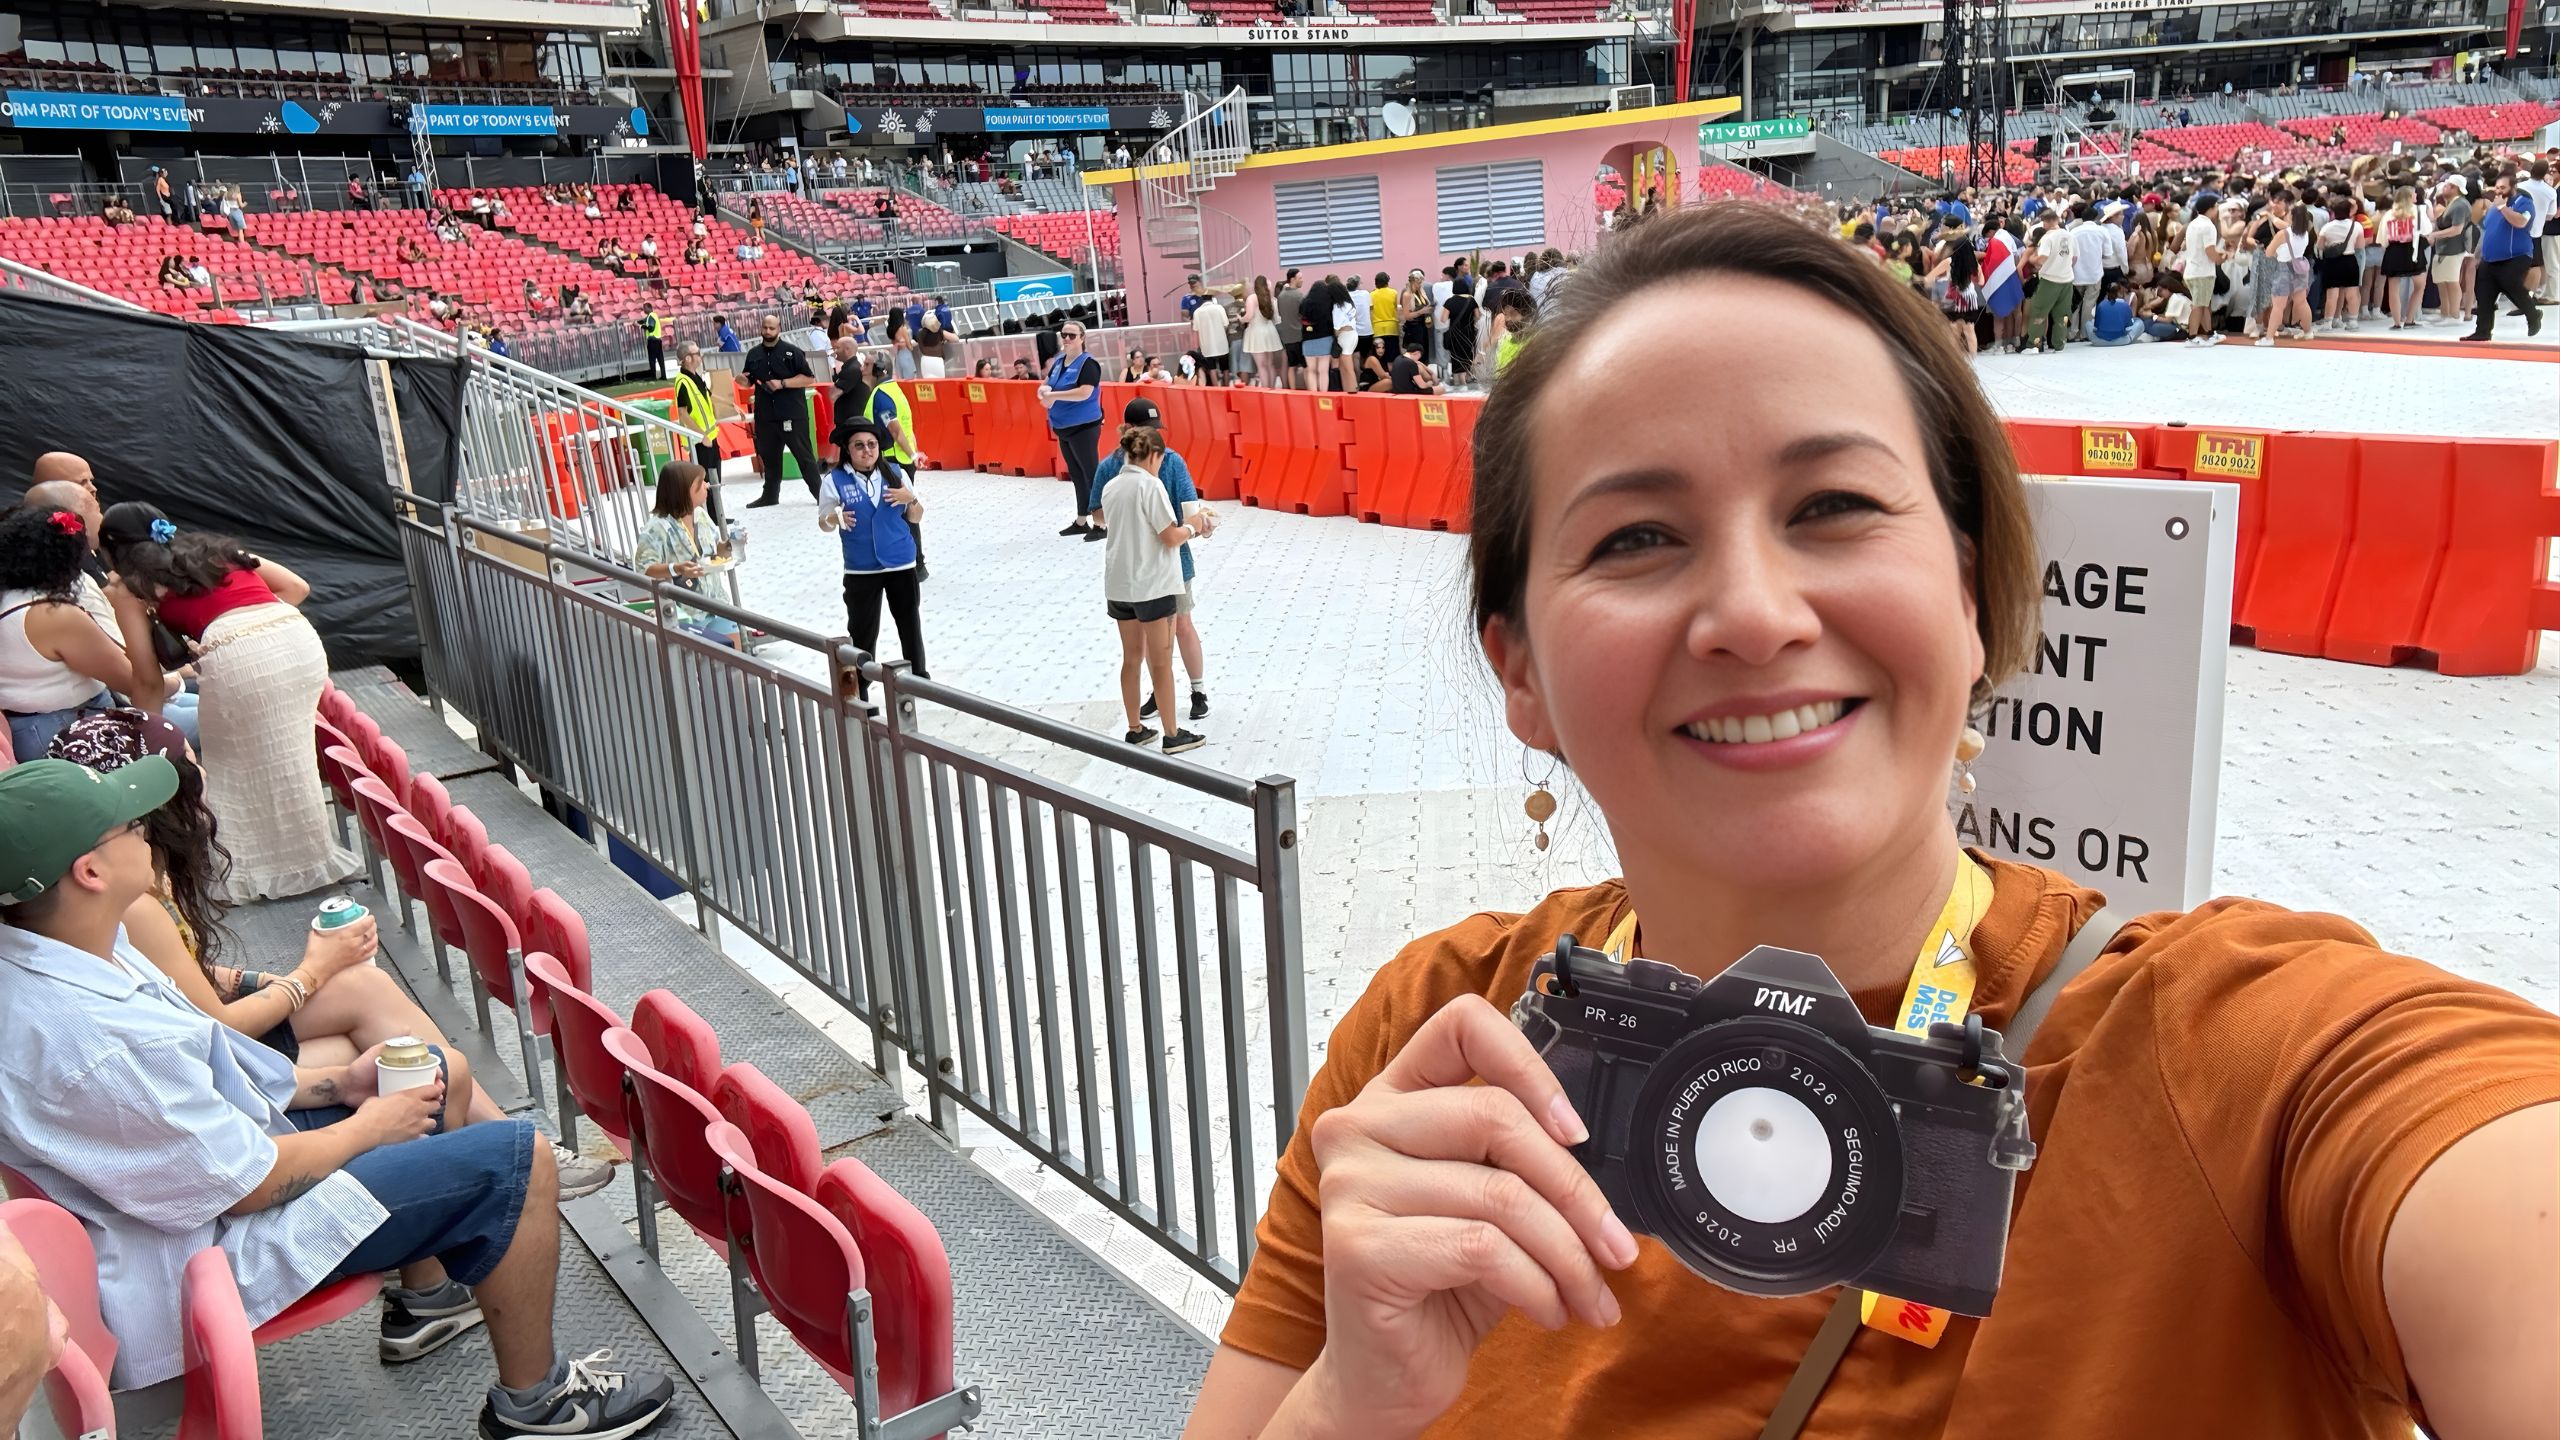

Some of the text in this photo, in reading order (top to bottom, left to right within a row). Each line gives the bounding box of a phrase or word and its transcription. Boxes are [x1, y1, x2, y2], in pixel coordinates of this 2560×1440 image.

[1248, 29, 1349, 40] SUTTOR STAND
[42, 103, 77, 118] PART
[81, 104, 100, 119] OF
[102, 105, 161, 121] TODAY'S
[164, 107, 205, 123] EVENT
[430, 114, 460, 127] PART
[463, 114, 479, 127] OF
[481, 114, 532, 127] TODAY'S
[534, 114, 570, 128] EVENT
[1738, 125, 1761, 138] EXIT
[2091, 432, 2127, 450] TFH
[2206, 435, 2250, 457] TFH
[2088, 449, 2133, 462] 9820 9022
[2201, 454, 2256, 470] 9820 9022
[2043, 559, 2148, 615] AGE
[2022, 630, 2108, 682] NT
[1987, 696, 2103, 756] TION
[1954, 802, 2149, 884] ANS OR
[1753, 987, 1817, 1016] DTMF
[1907, 984, 1937, 1029] MáS
[1584, 1005, 1606, 1023] PR
[1618, 1013, 1637, 1029] 26
[1790, 1066, 1837, 1105] 2026
[1665, 1057, 1761, 1191] MADE IN PUERTO RICO
[1814, 1127, 1863, 1244] SEGUIMO AQUÍ
[1696, 1211, 1742, 1247] 2026
[1772, 1237, 1798, 1254] PR
